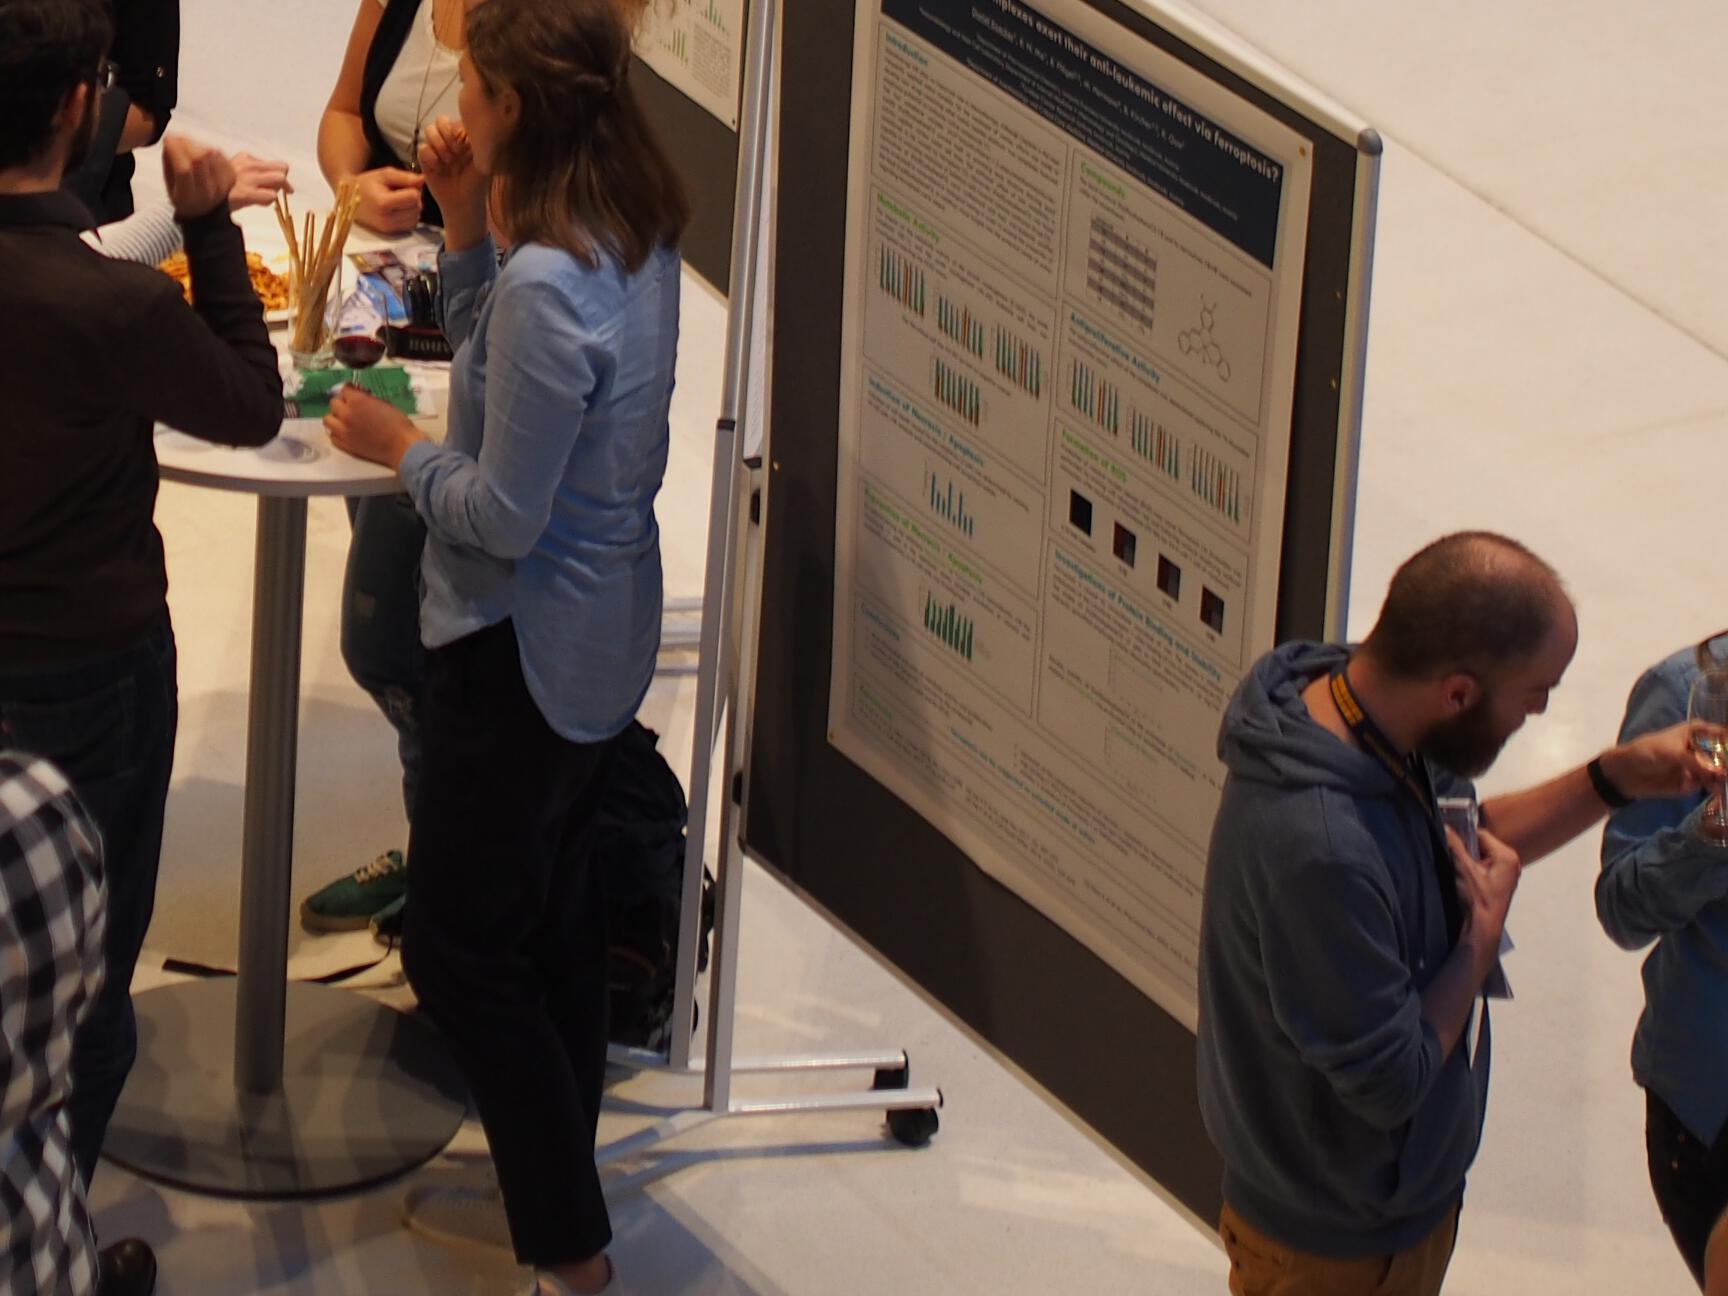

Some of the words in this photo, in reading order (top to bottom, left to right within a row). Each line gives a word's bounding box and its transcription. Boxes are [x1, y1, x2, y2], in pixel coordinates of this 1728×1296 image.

[1035, 20, 1062, 46] exert
[1063, 35, 1088, 61] their
[1089, 53, 1160, 109] anti-leukemic
[1161, 98, 1193, 130] effect
[1194, 118, 1212, 141] via
[1213, 132, 1280, 184] ferroptosis?
